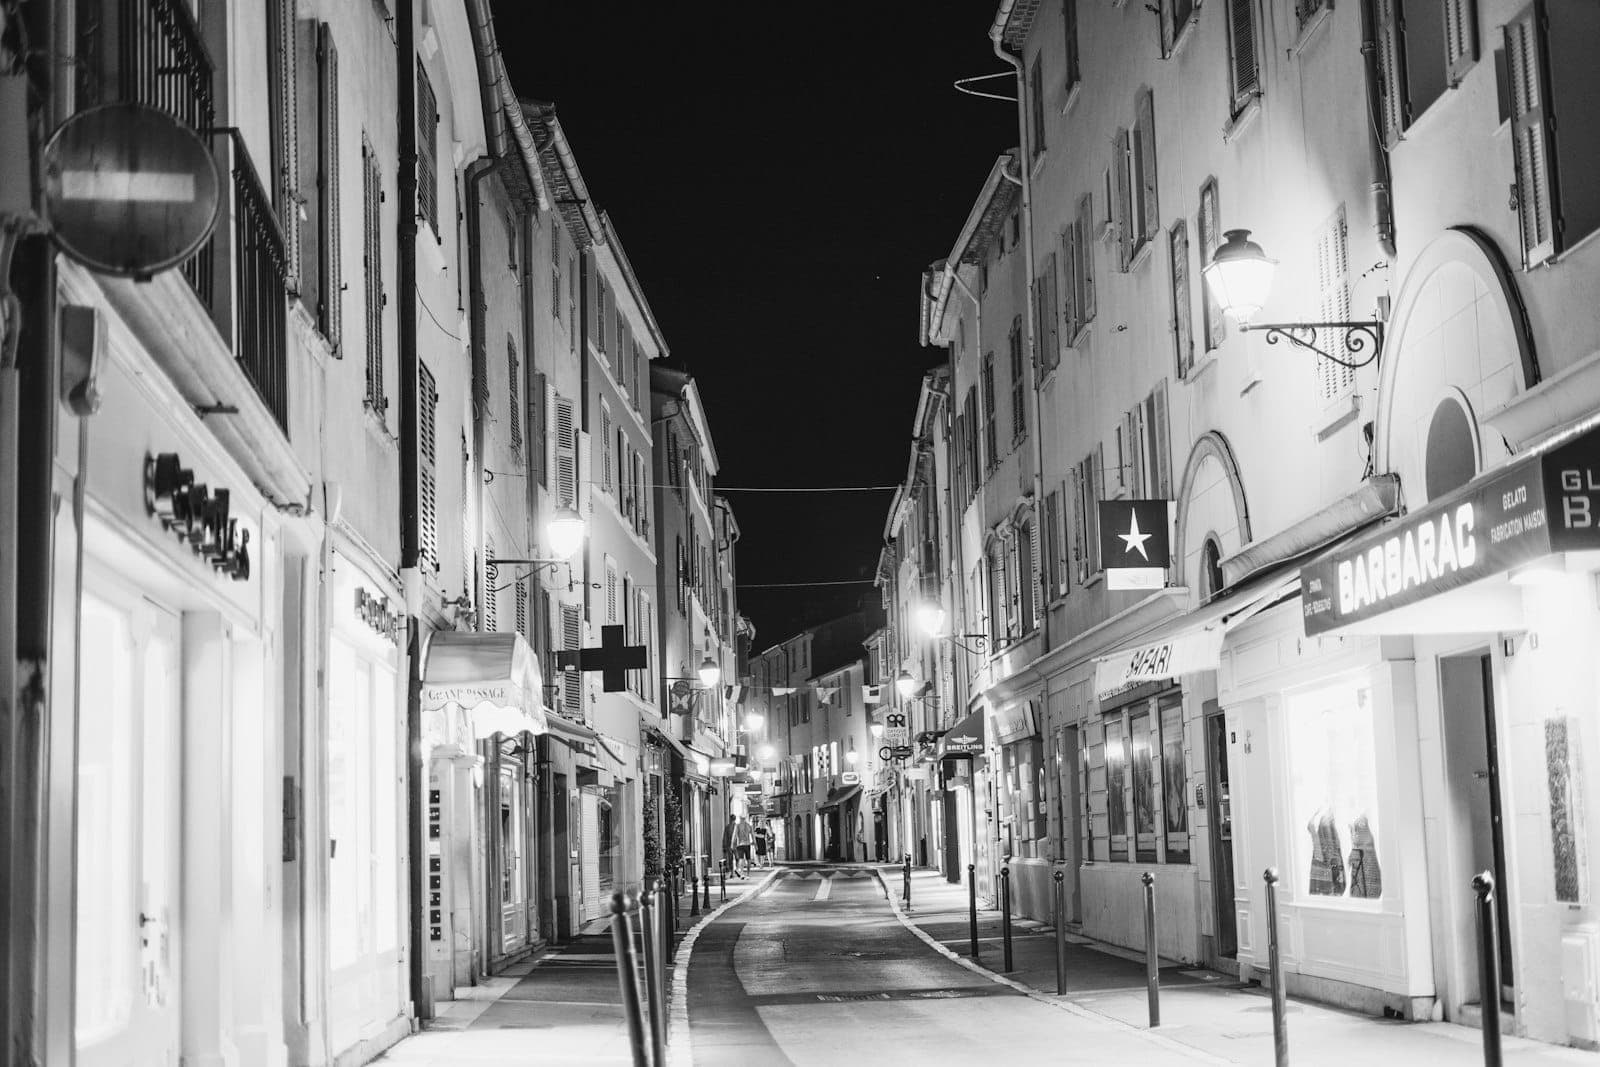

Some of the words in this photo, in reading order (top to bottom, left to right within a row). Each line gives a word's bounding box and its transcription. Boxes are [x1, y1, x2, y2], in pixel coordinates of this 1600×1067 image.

[1502, 486, 1527, 511] GELATO
[1491, 516, 1523, 544] FABRICATION
[1524, 508, 1546, 532] MAISON
[1338, 503, 1475, 615] BARBARAC
